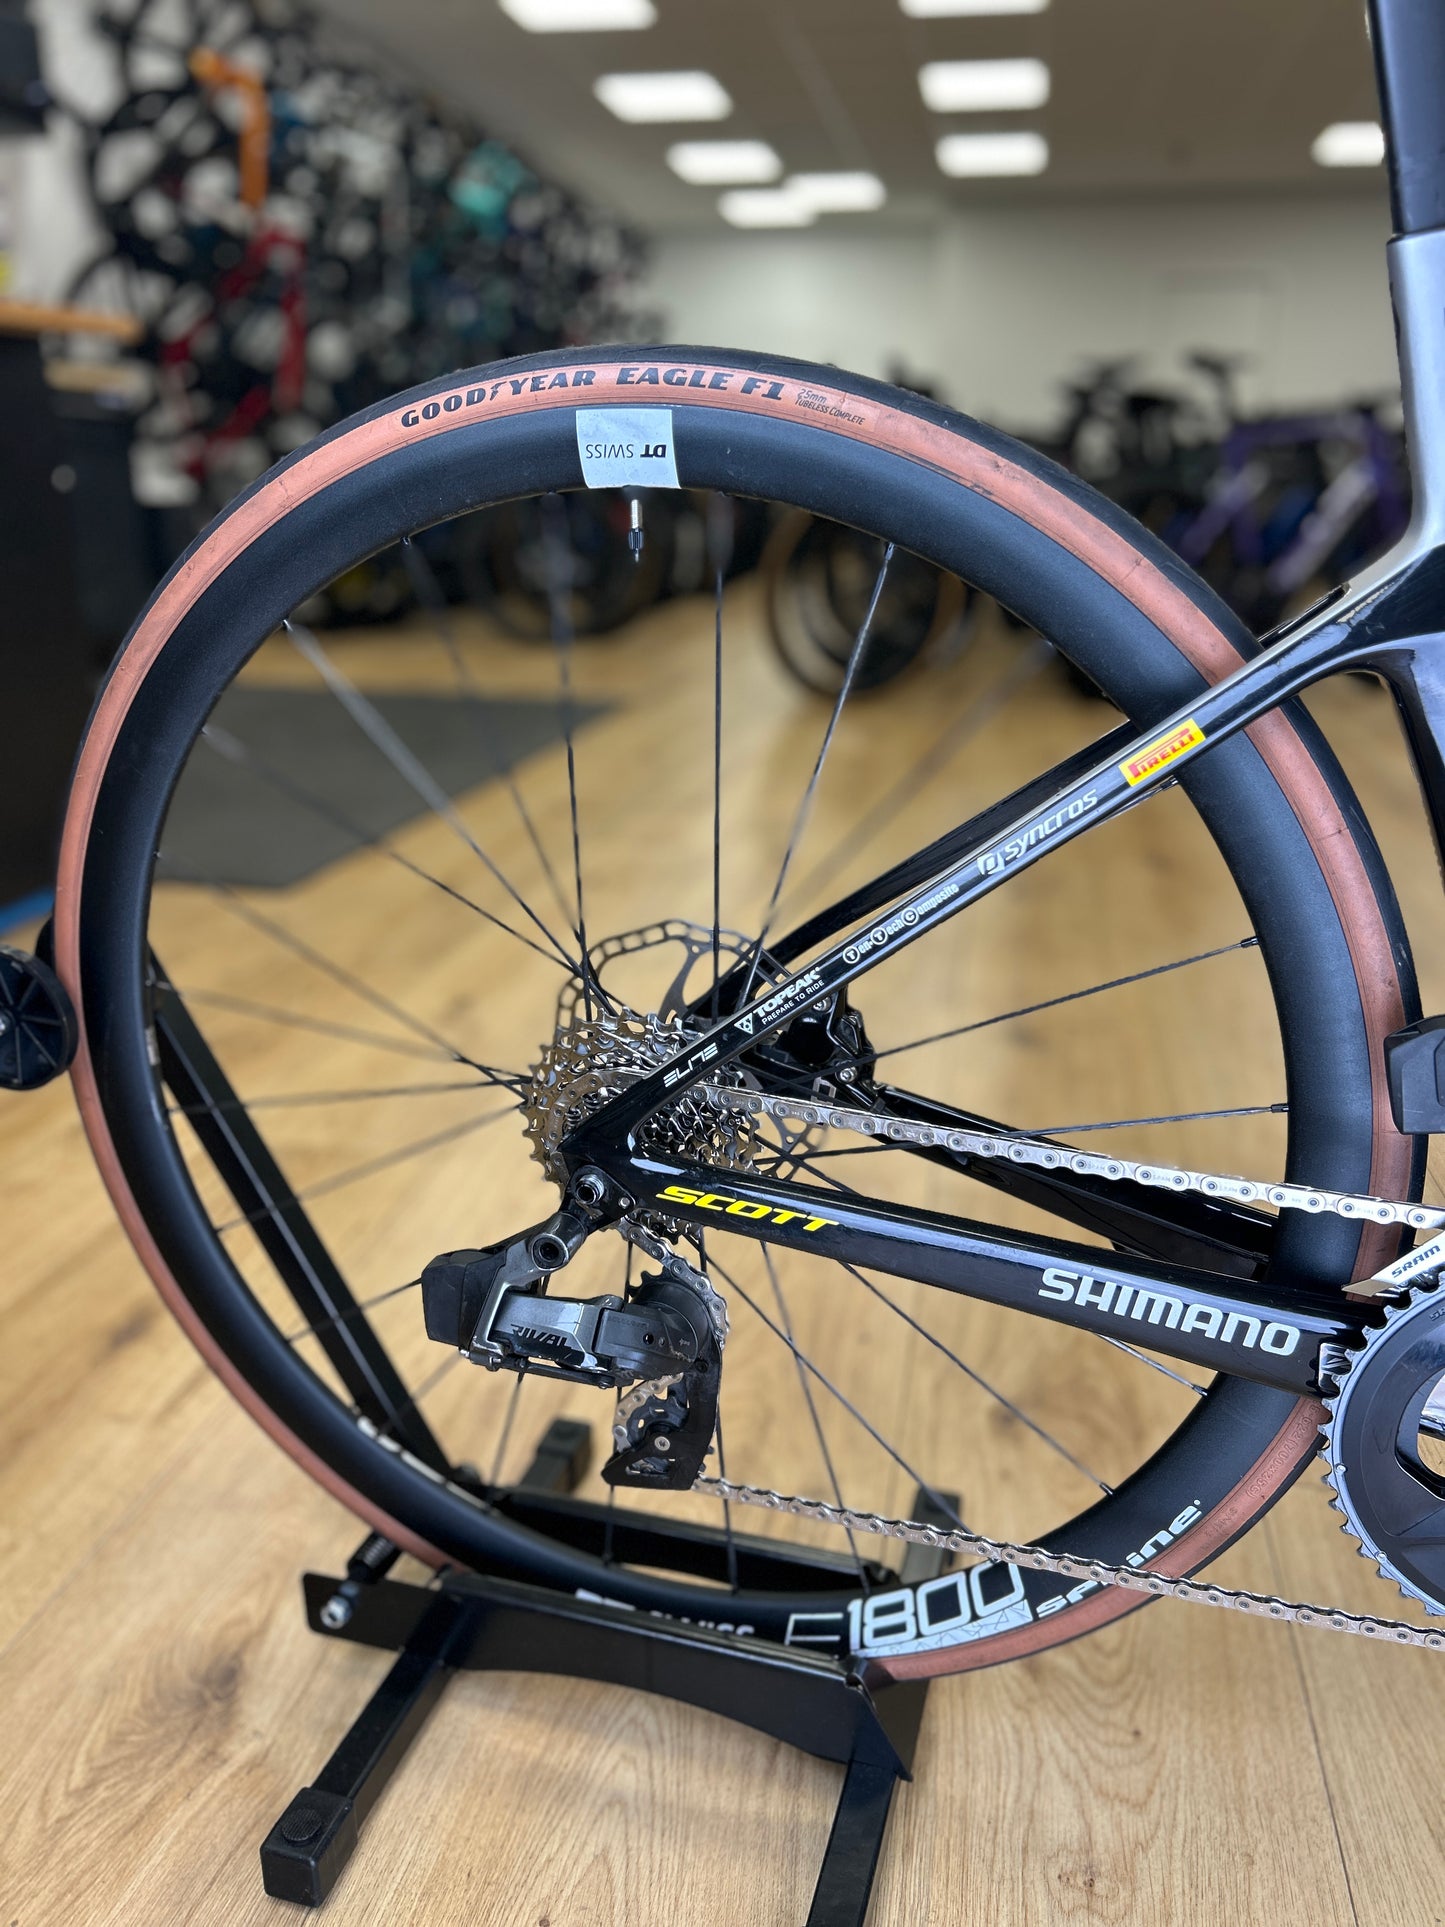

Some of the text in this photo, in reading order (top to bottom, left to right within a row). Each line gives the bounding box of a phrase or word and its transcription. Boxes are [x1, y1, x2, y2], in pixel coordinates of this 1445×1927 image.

[400, 366, 784, 428] GOODYEAR EAGLE F1
[794, 398, 866, 426] TUBELESS COMPLETE
[798, 387, 827, 404] 25mm
[586, 442, 667, 459] DT SWISS
[1129, 728, 1195, 778] PIRELLI
[753, 968, 820, 1018] TOPEAK
[656, 1186, 840, 1231] SCOTT
[1392, 1245, 1440, 1278] SRAM
[1038, 1267, 1300, 1356] SHIMANO
[511, 1323, 572, 1350] RIVAL
